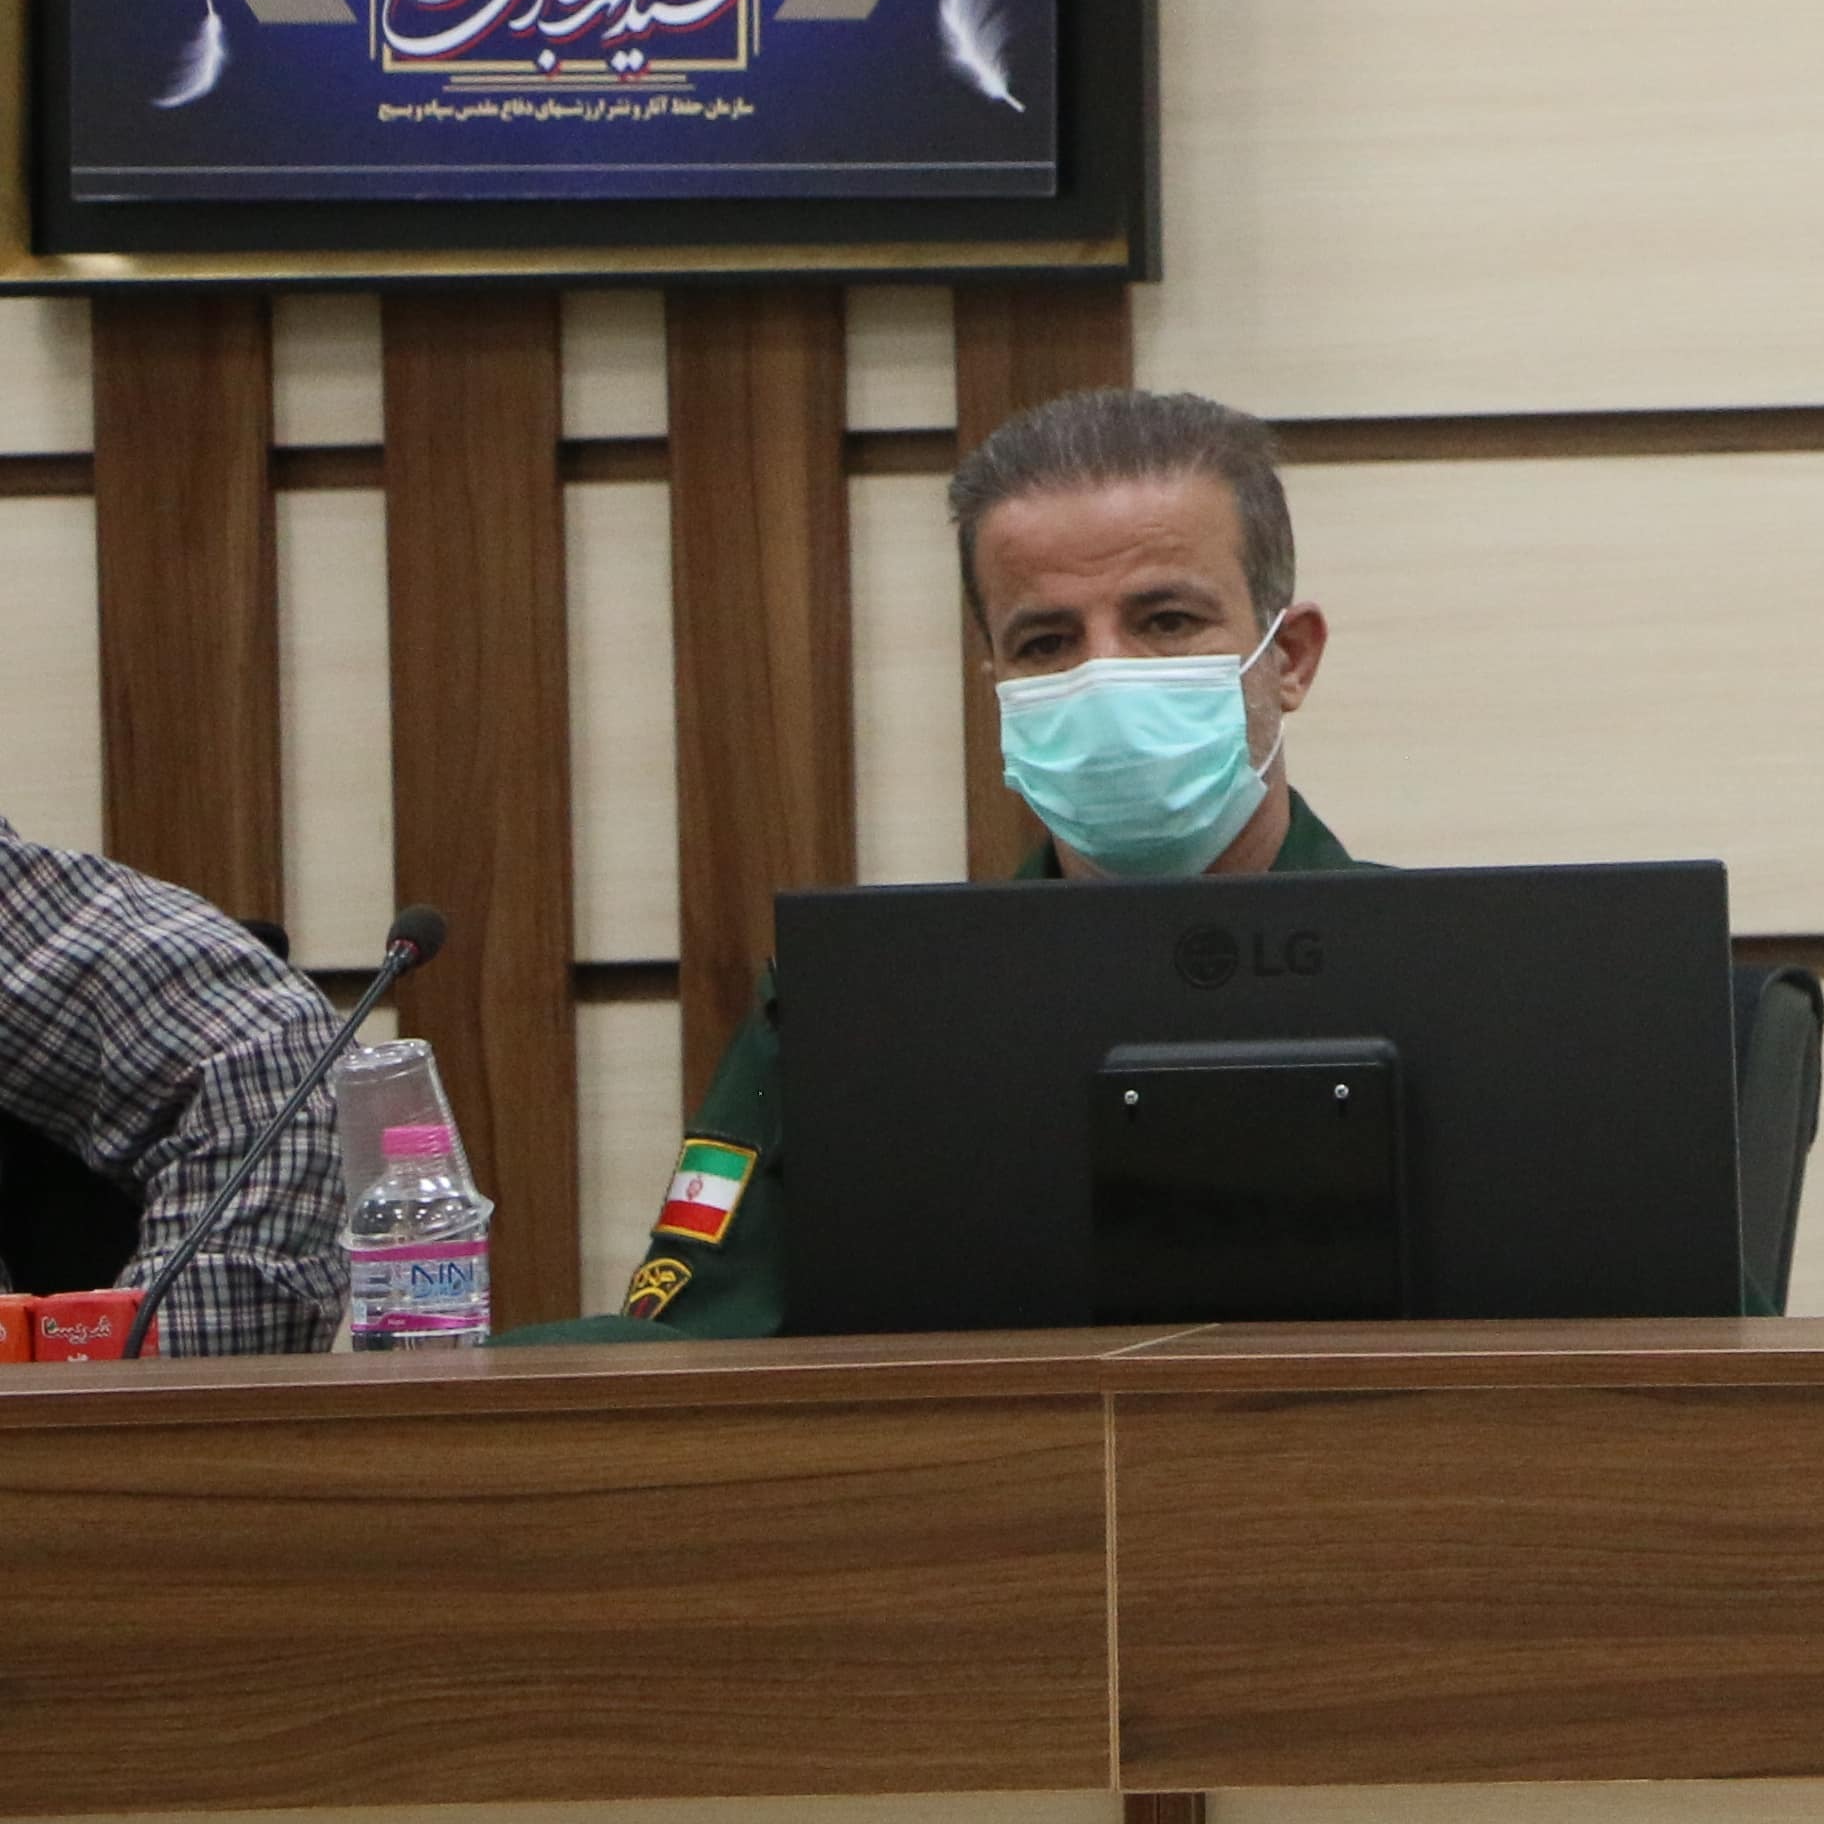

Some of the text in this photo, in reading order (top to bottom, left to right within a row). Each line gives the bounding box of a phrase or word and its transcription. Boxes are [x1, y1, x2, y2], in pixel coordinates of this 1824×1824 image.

[377, 102, 414, 124] بسیج
[454, 97, 500, 123] مقدس
[500, 96, 535, 123] دفاع
[605, 96, 632, 122] نشر
[641, 92, 670, 122] آثار
[670, 94, 704, 118] حفظ
[703, 94, 757, 122] سازمان
[1253, 928, 1325, 976] LG
